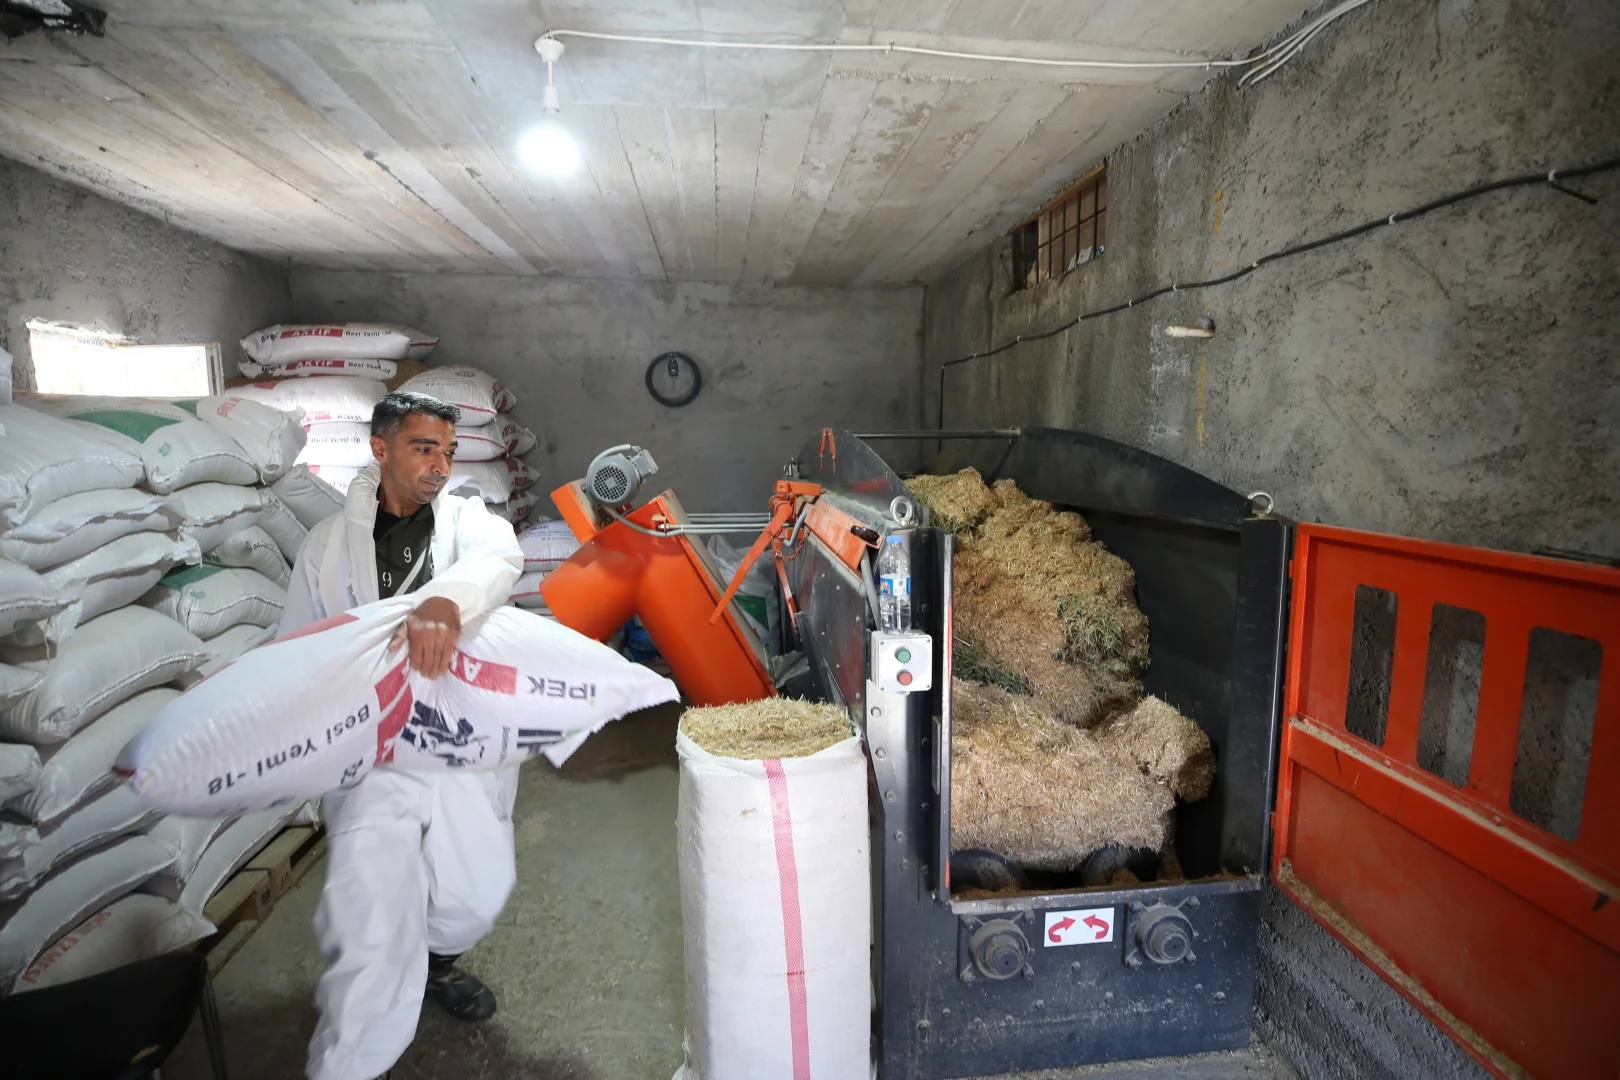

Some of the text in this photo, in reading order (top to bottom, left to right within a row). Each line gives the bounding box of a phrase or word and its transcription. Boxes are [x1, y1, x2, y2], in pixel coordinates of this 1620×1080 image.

[403, 546, 412, 563] 9
[326, 704, 370, 744] Besi
[256, 738, 317, 777] Yemi
